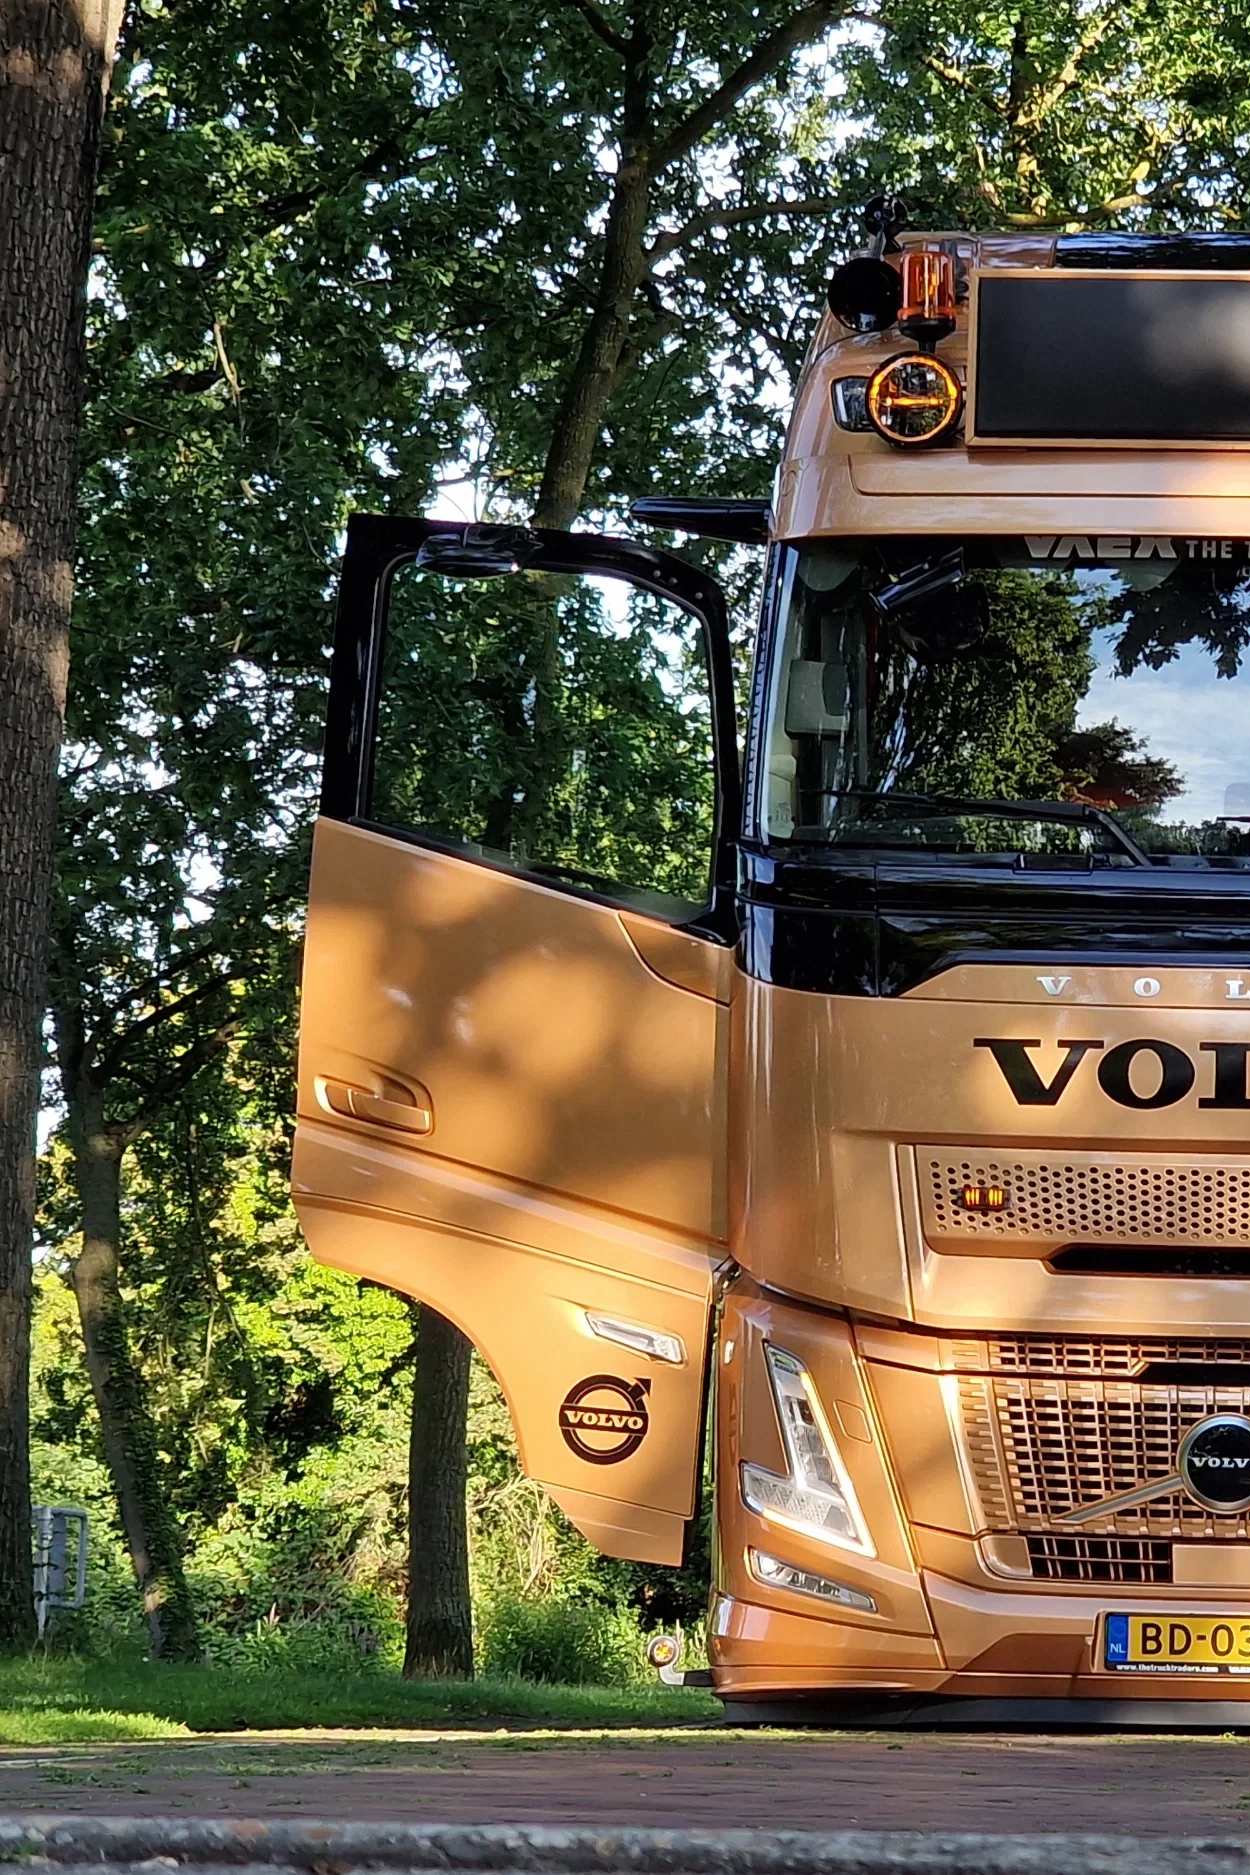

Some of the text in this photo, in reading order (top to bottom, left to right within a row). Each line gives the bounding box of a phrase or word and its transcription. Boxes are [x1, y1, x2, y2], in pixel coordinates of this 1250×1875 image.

[1185, 540, 1233, 559] THE
[563, 1410, 644, 1430] VOLVO
[1110, 1643, 1127, 1654] NL
